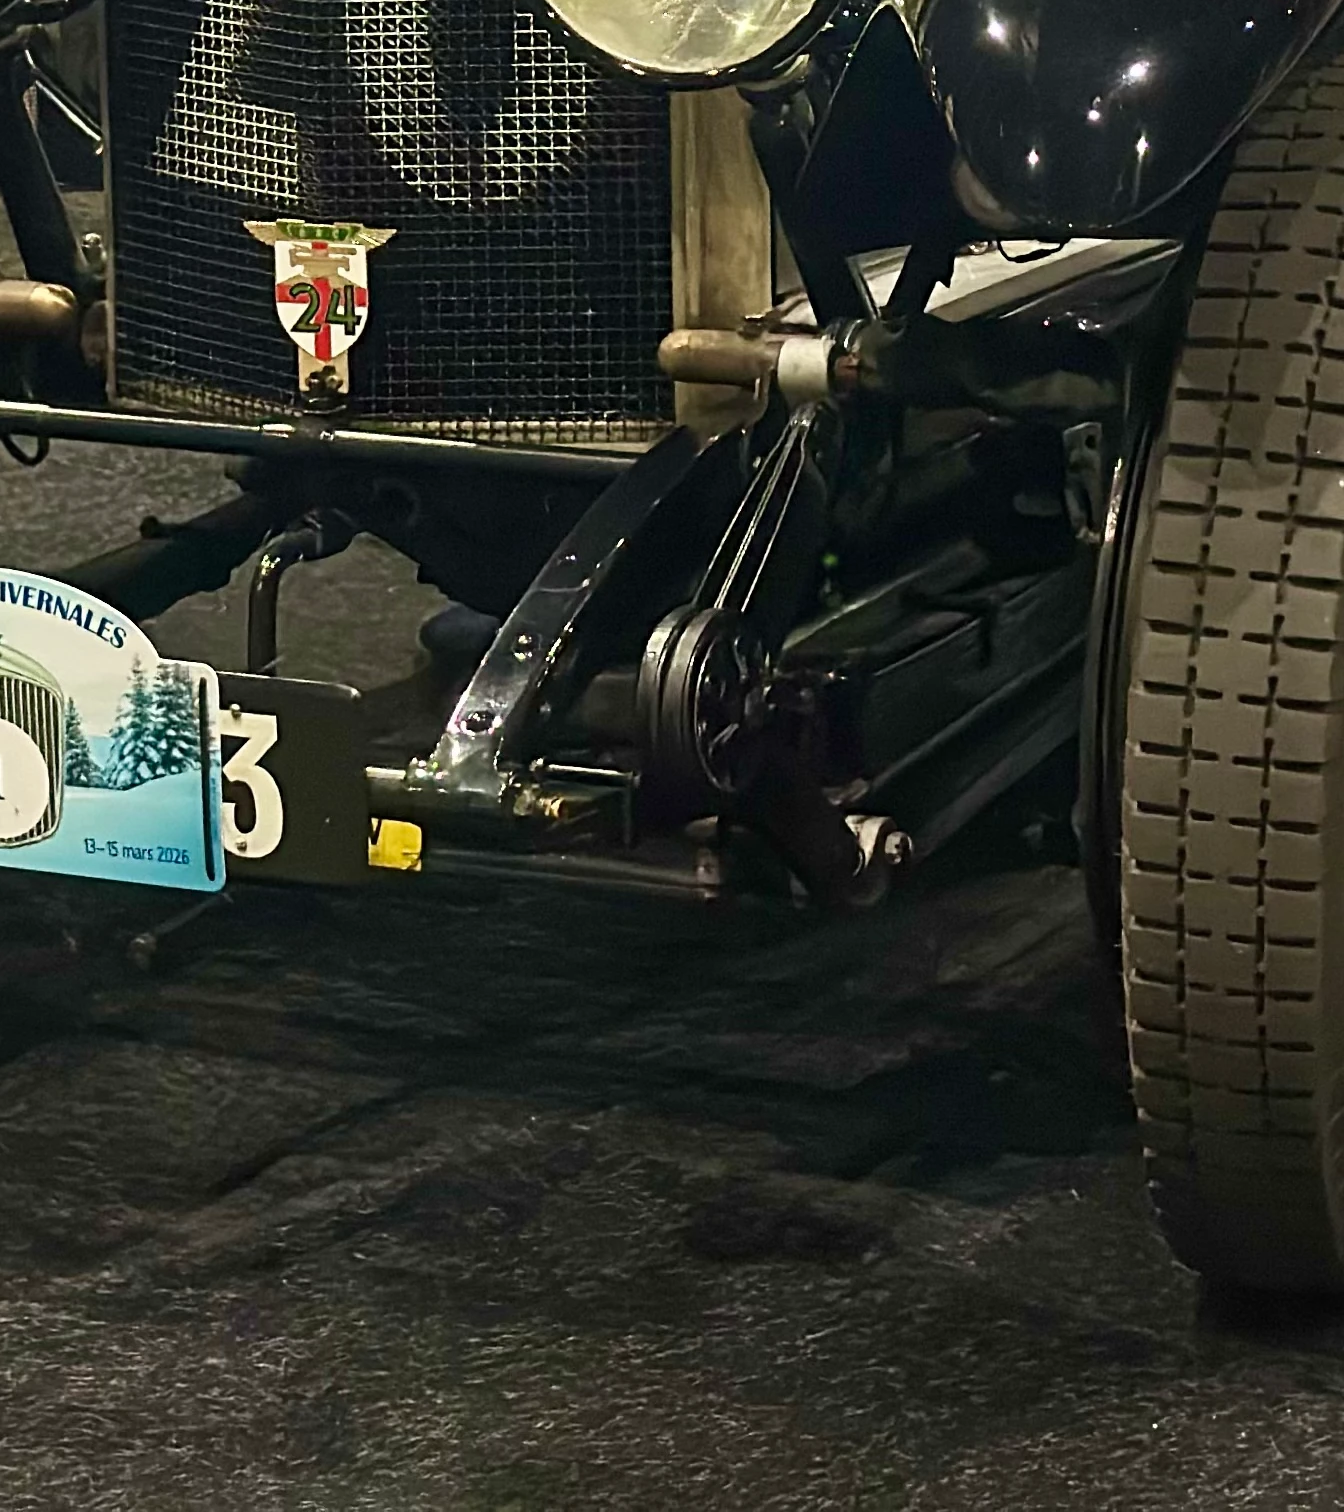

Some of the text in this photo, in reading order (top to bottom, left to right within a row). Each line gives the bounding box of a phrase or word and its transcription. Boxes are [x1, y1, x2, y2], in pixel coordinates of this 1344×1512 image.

[289, 281, 362, 336] 24
[122, 842, 154, 863] mars
[156, 845, 191, 865] 2026
